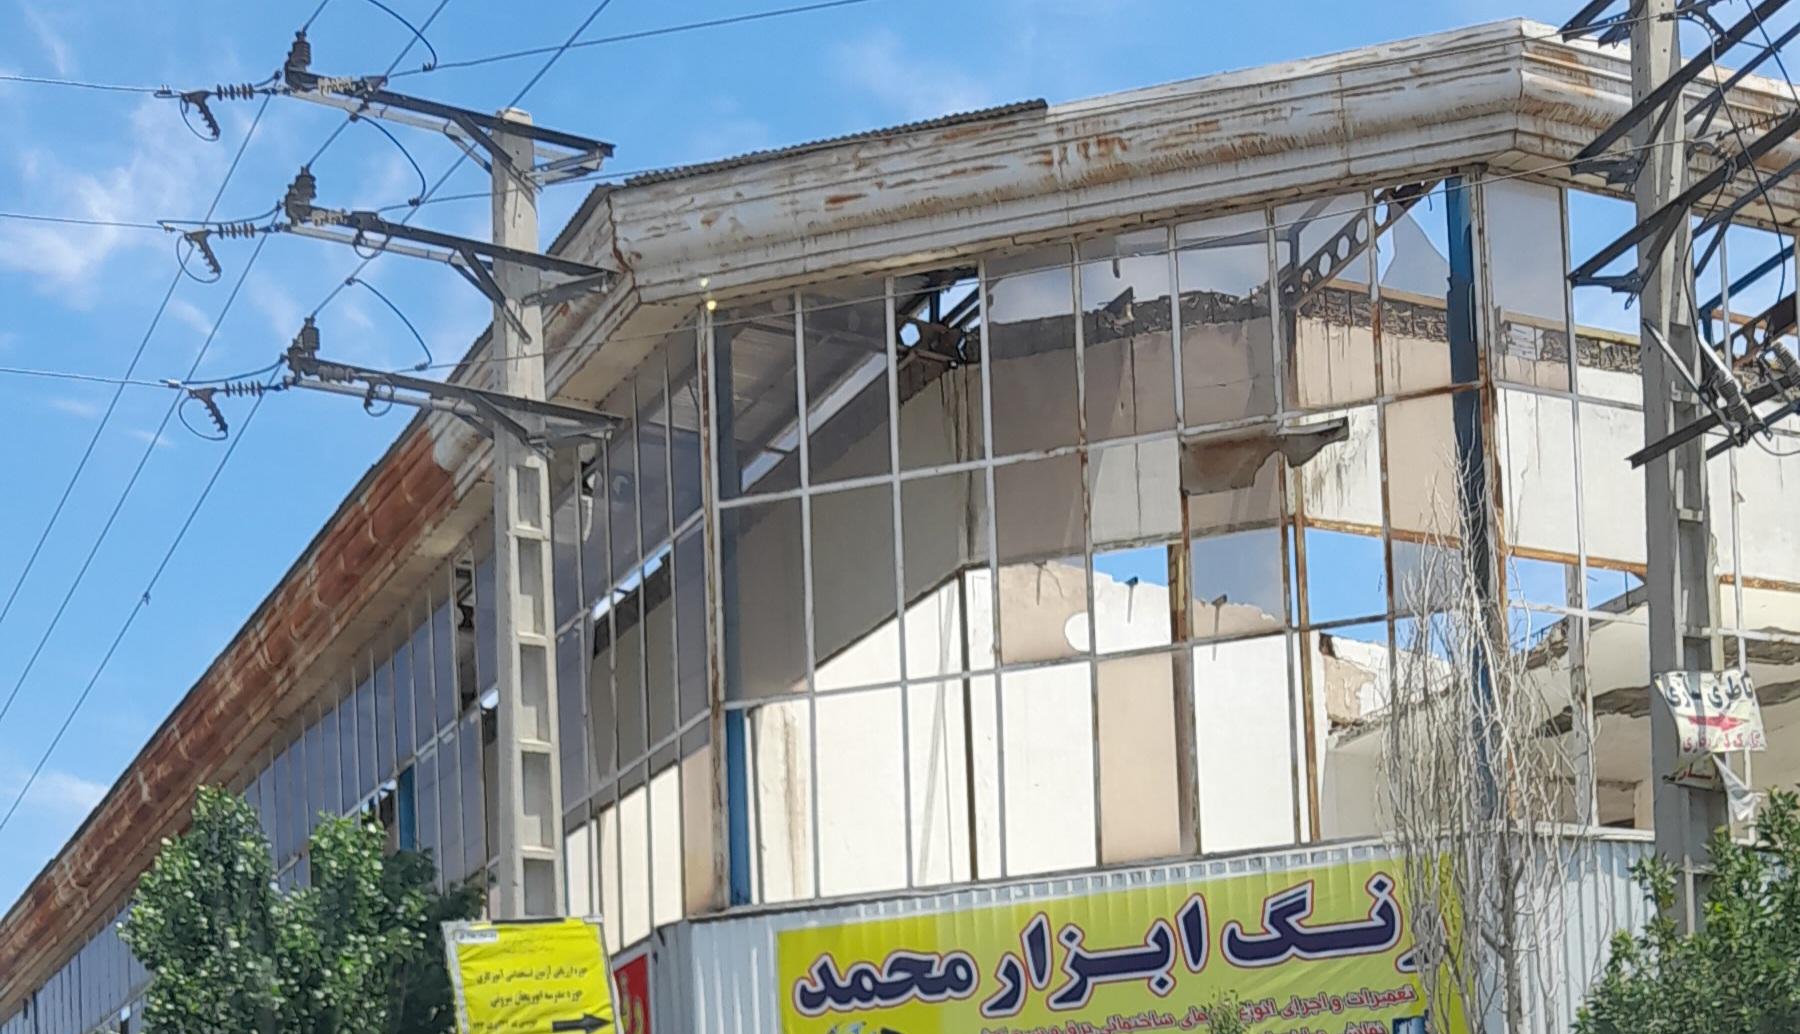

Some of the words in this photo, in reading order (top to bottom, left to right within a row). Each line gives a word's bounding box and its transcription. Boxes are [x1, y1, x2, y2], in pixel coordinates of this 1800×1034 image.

[980, 893, 1210, 1019] ابزار
[792, 950, 979, 1018] محمد
[1346, 983, 1419, 1012] تعمیرات
[1280, 991, 1328, 1019] اجرای
[1330, 995, 1344, 1014] و
